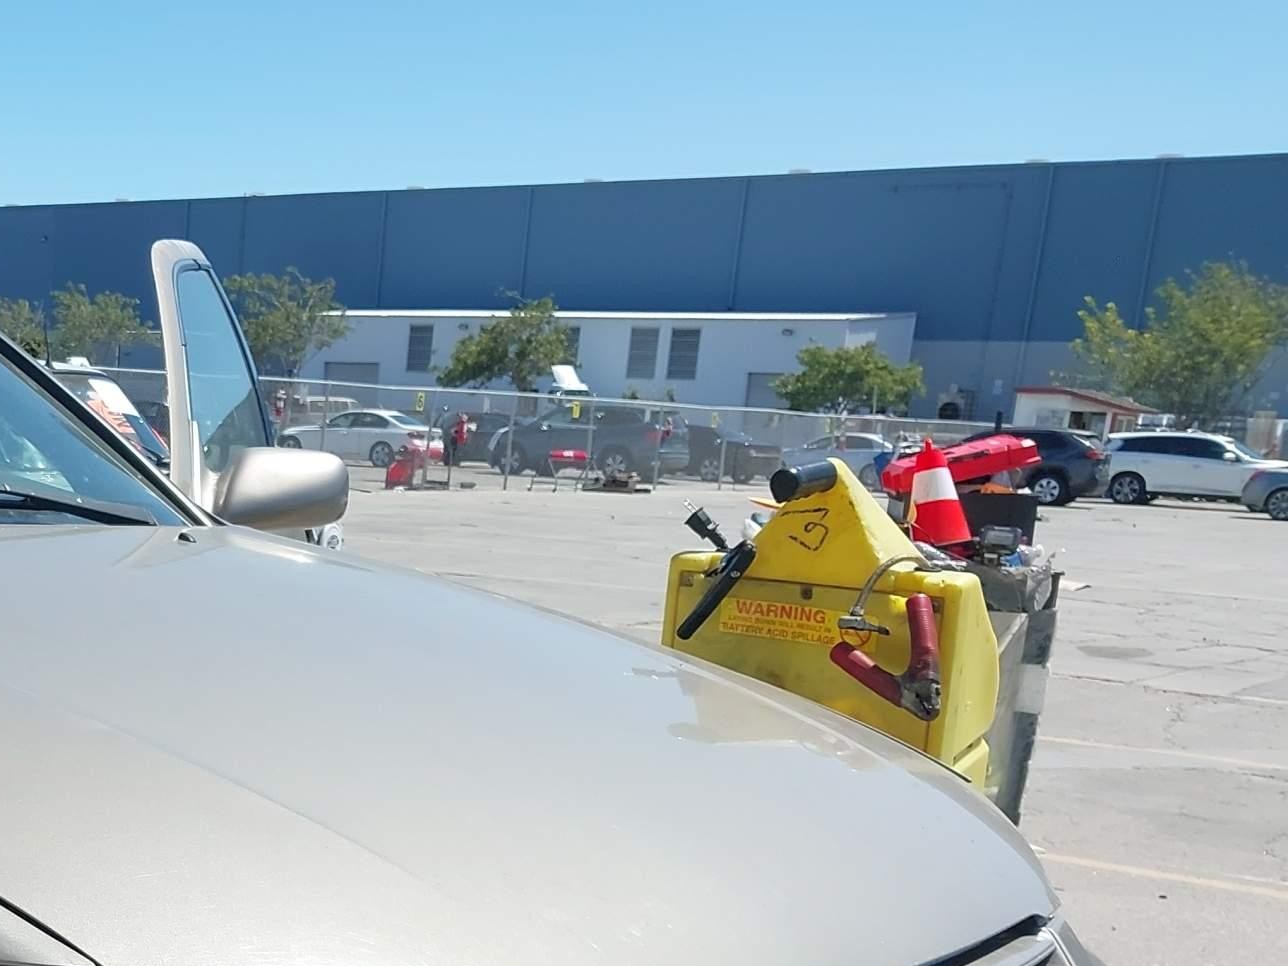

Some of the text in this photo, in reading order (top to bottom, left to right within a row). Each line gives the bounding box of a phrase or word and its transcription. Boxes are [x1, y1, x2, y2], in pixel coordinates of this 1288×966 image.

[735, 599, 826, 624] WARNING
[721, 622, 764, 634] BATTERY
[766, 627, 788, 637] ACID
[790, 631, 836, 645] SPILLAGE
